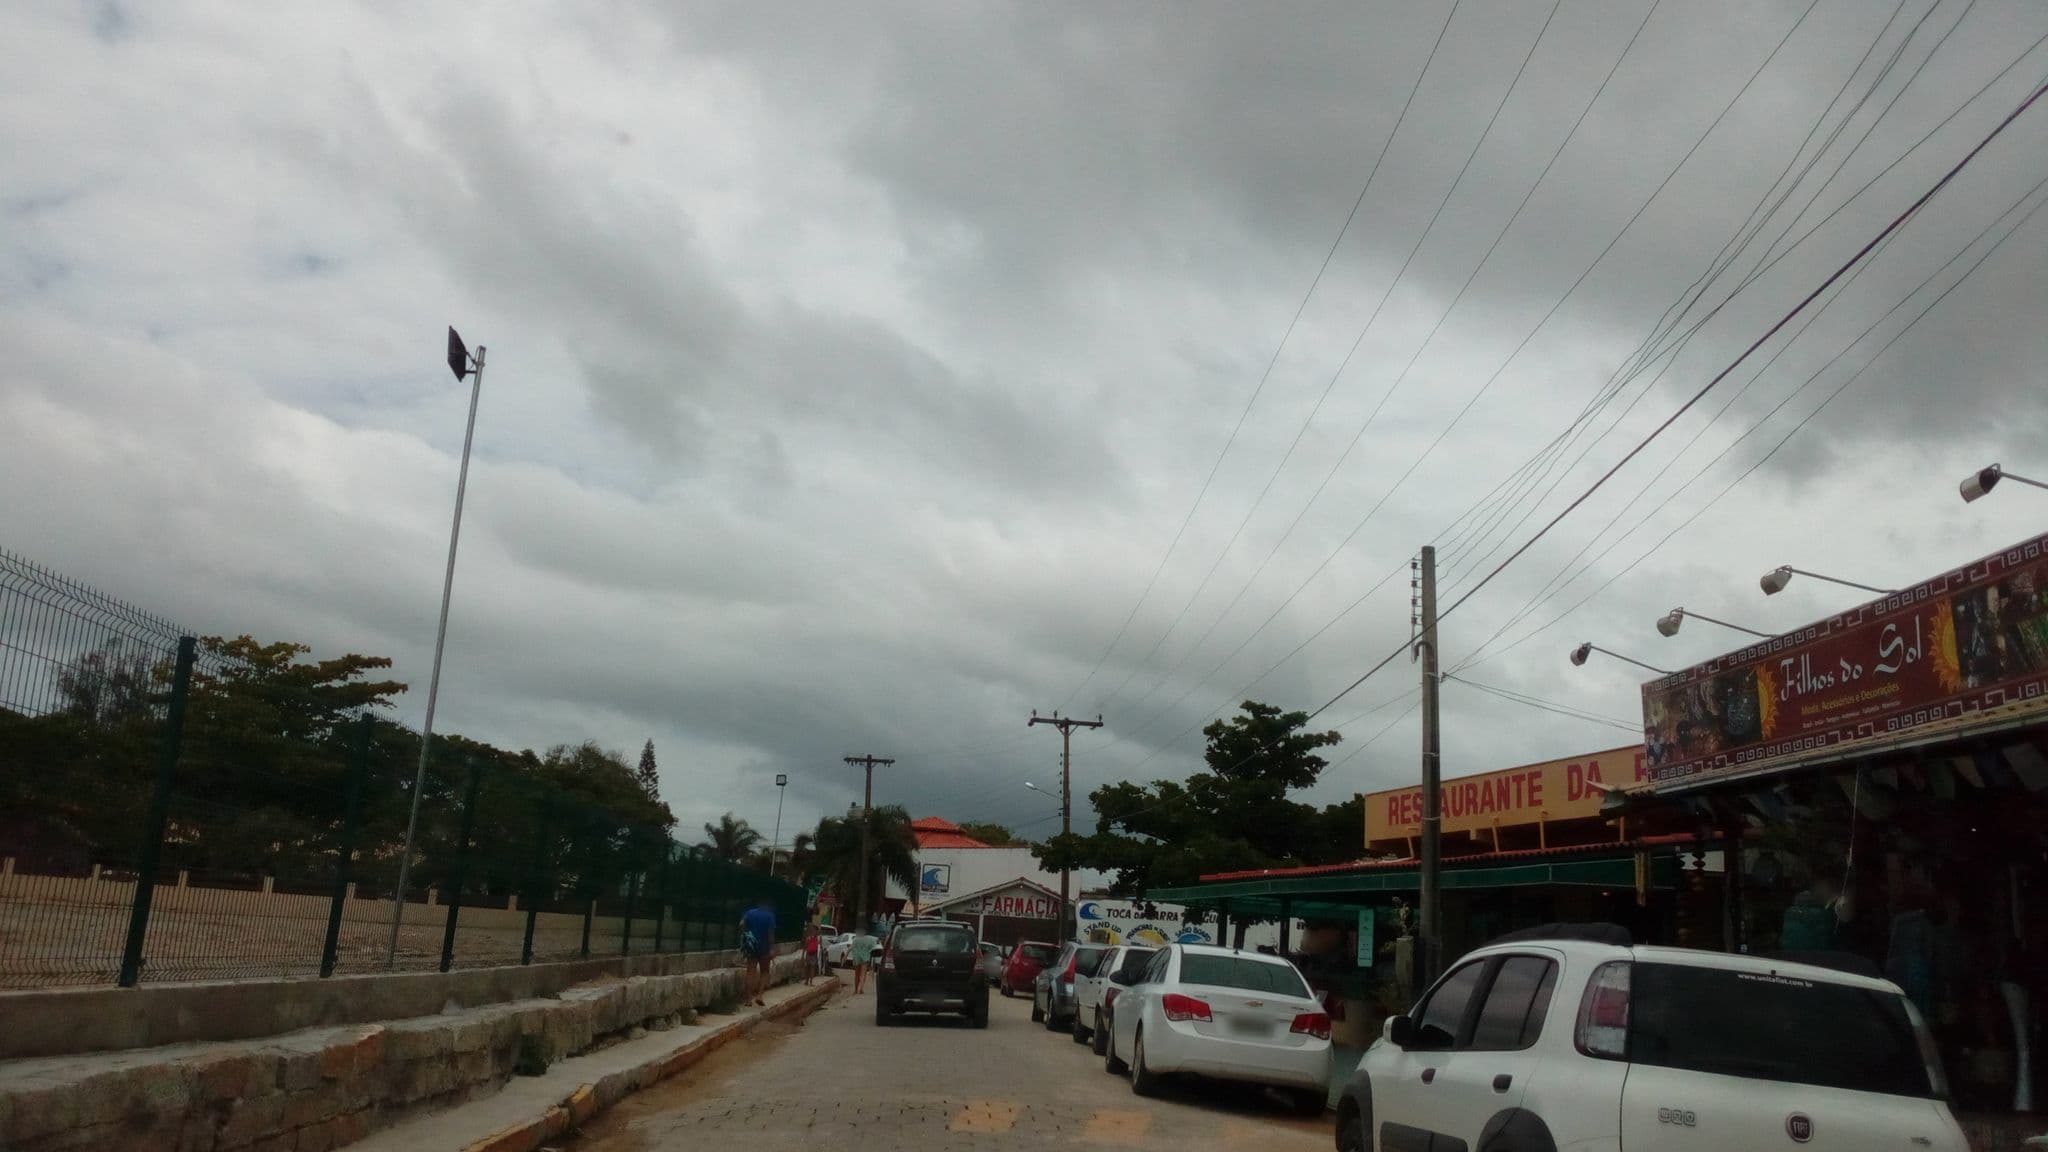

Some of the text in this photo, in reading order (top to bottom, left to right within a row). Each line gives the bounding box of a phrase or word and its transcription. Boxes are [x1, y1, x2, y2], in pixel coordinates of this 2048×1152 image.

[1780, 614, 1922, 701] Filhos do Sol
[1388, 771, 1544, 826] RESAURANTE
[1567, 761, 1604, 801] DA
[1106, 908, 1131, 919] TOCA
[1148, 911, 1179, 921] ARRA
